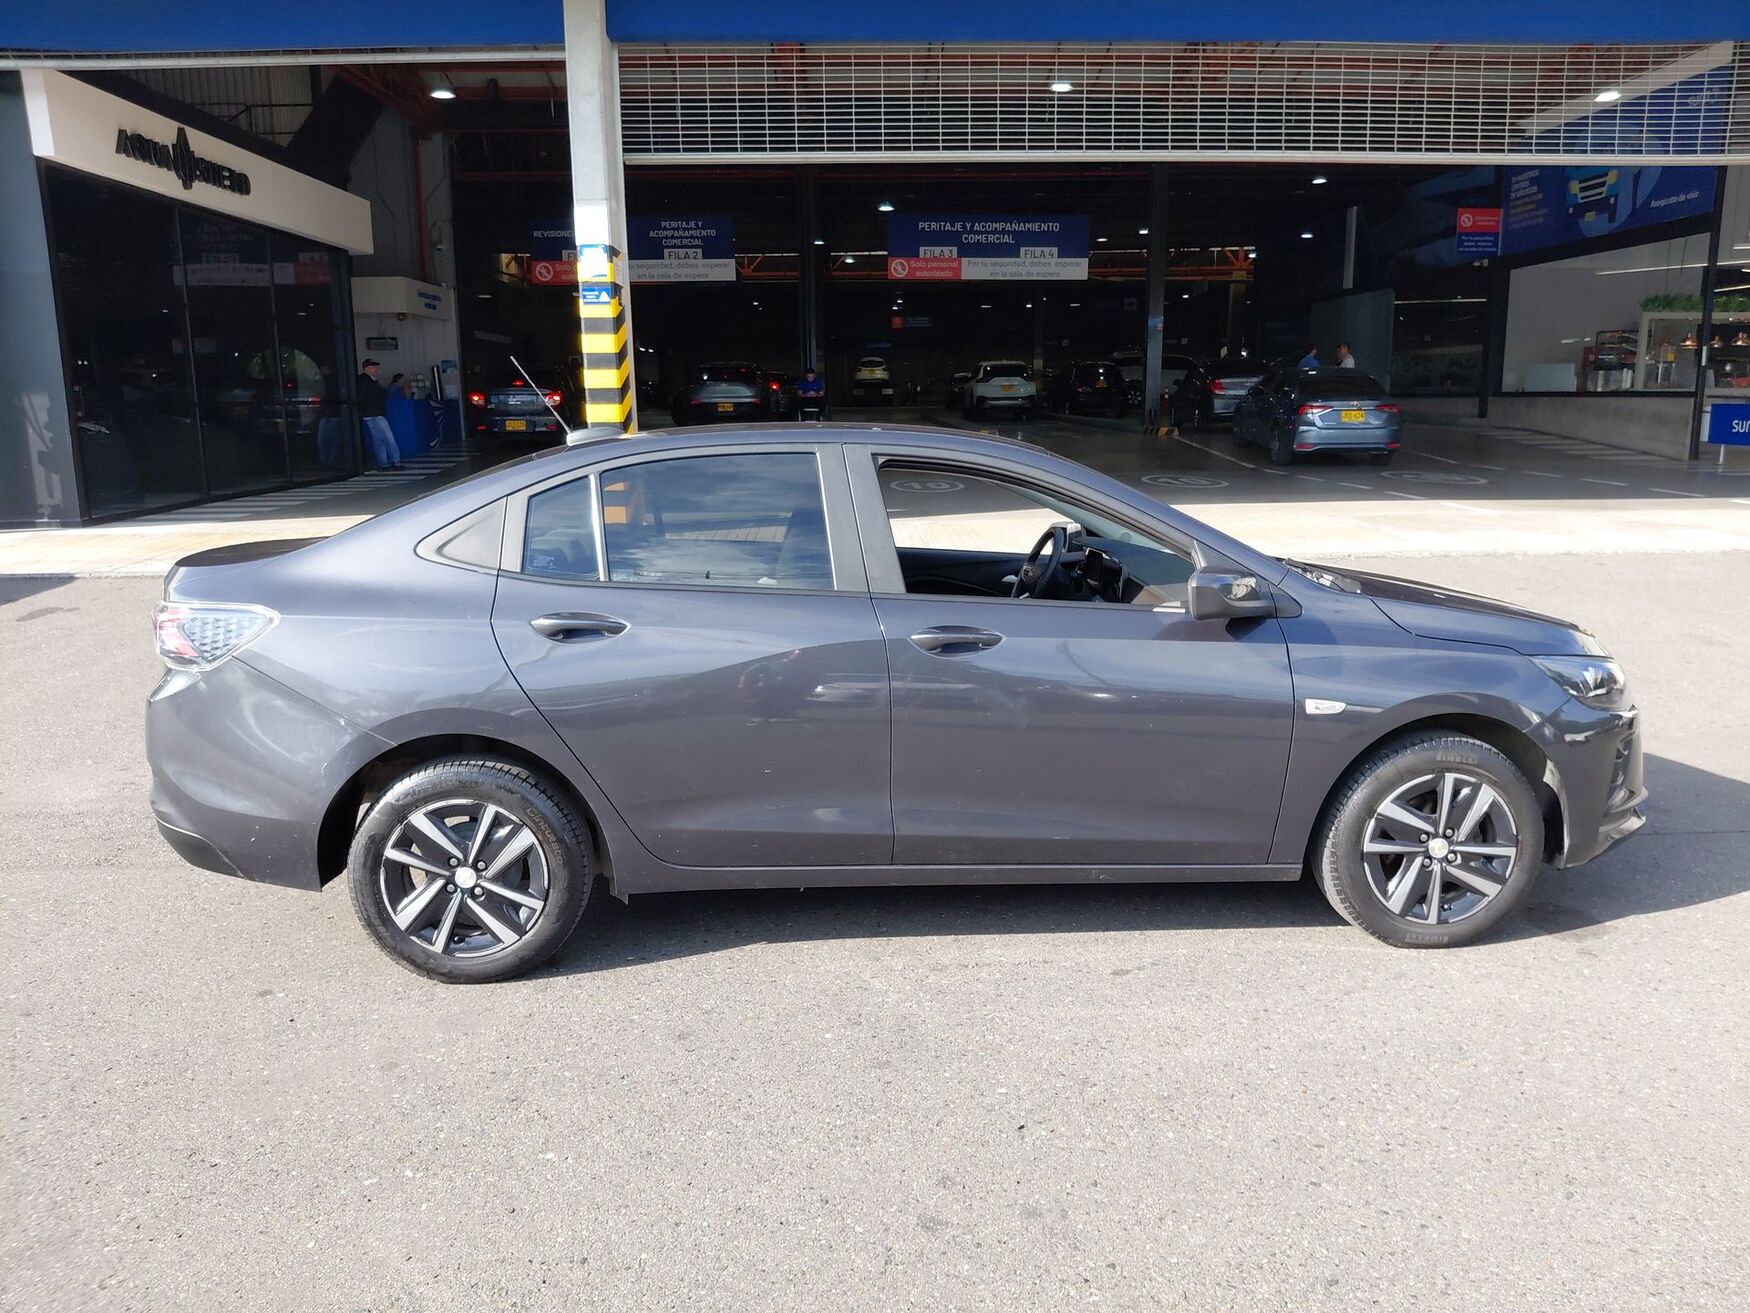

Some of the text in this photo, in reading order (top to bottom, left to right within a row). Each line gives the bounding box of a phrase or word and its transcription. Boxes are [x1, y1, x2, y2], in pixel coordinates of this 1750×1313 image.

[661, 221, 697, 229] PERITAJE
[918, 220, 1060, 231] PERITAJE Y ACOMPAÑAMIENTO
[649, 229, 717, 238] ACOMPAÑAMIENTO
[962, 234, 1016, 244] COMERCIAL
[668, 251, 699, 260] FILA 2
[923, 249, 954, 258] FILA 3
[1024, 249, 1055, 258] FILA 4
